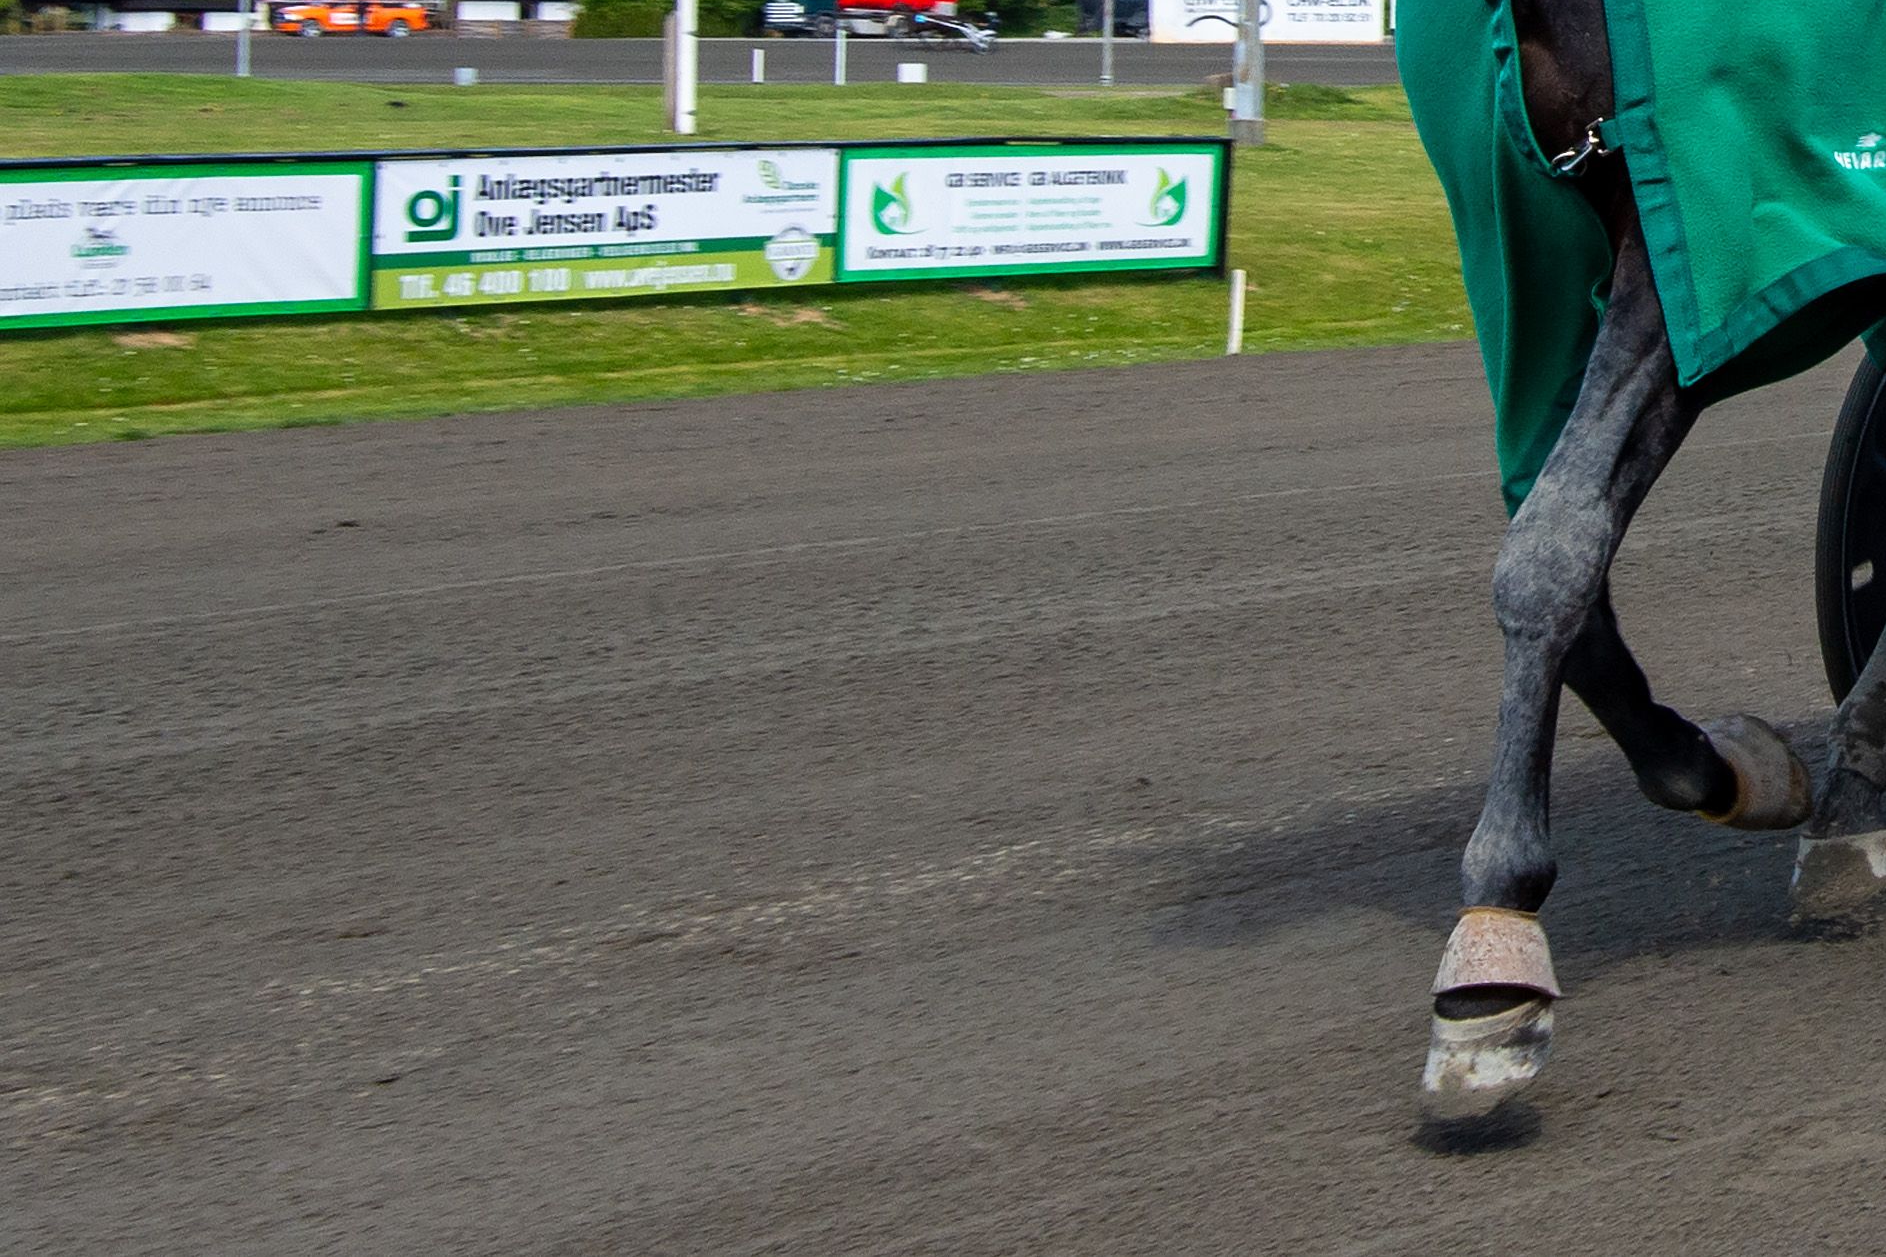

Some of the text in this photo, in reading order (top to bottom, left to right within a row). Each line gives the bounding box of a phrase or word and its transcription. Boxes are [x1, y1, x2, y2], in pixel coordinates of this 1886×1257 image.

[475, 169, 721, 205] Anlægsgartnermester
[967, 172, 1021, 187] SERVICE
[474, 204, 659, 237] Ove Jensen ApS
